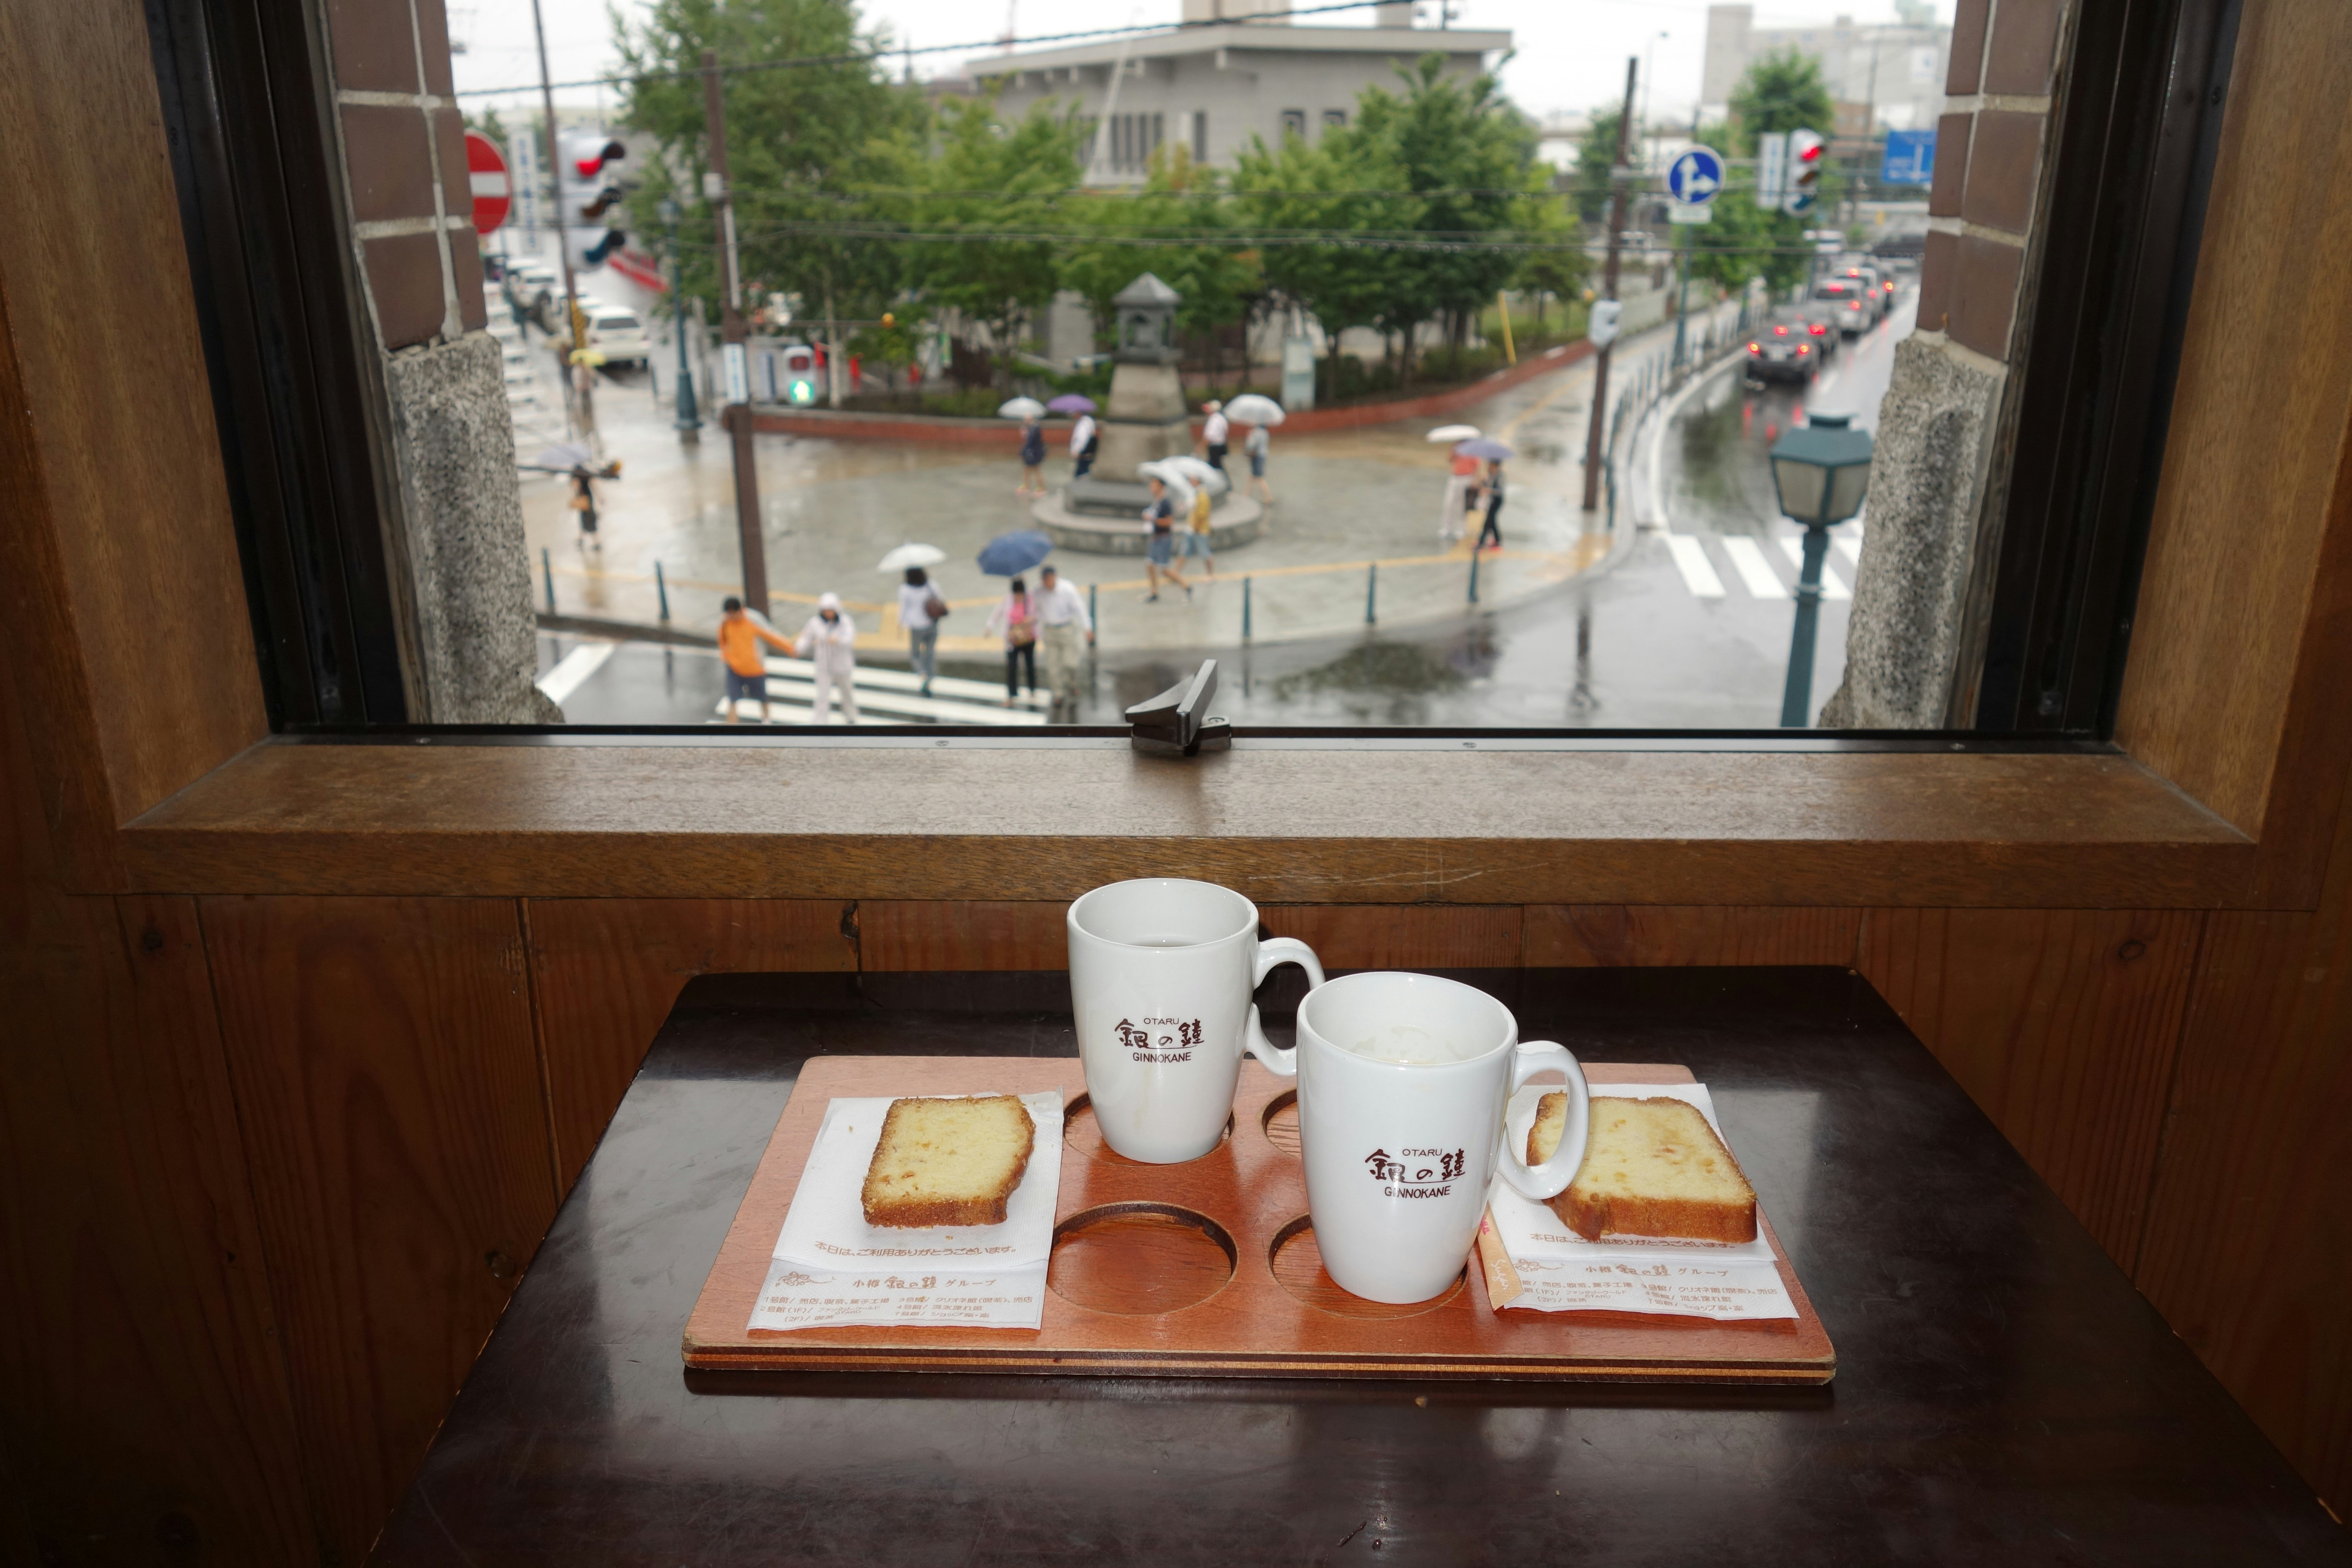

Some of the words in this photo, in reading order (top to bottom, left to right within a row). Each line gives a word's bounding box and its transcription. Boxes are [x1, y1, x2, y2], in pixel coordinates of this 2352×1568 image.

[1133, 1052, 1191, 1063] GINNOKANE
[1402, 1148, 1442, 1157] OTARU
[1384, 1185, 1451, 1198] GINNOKANE
[815, 1241, 1017, 1256] 本日は、ご利用ありがとうございます。
